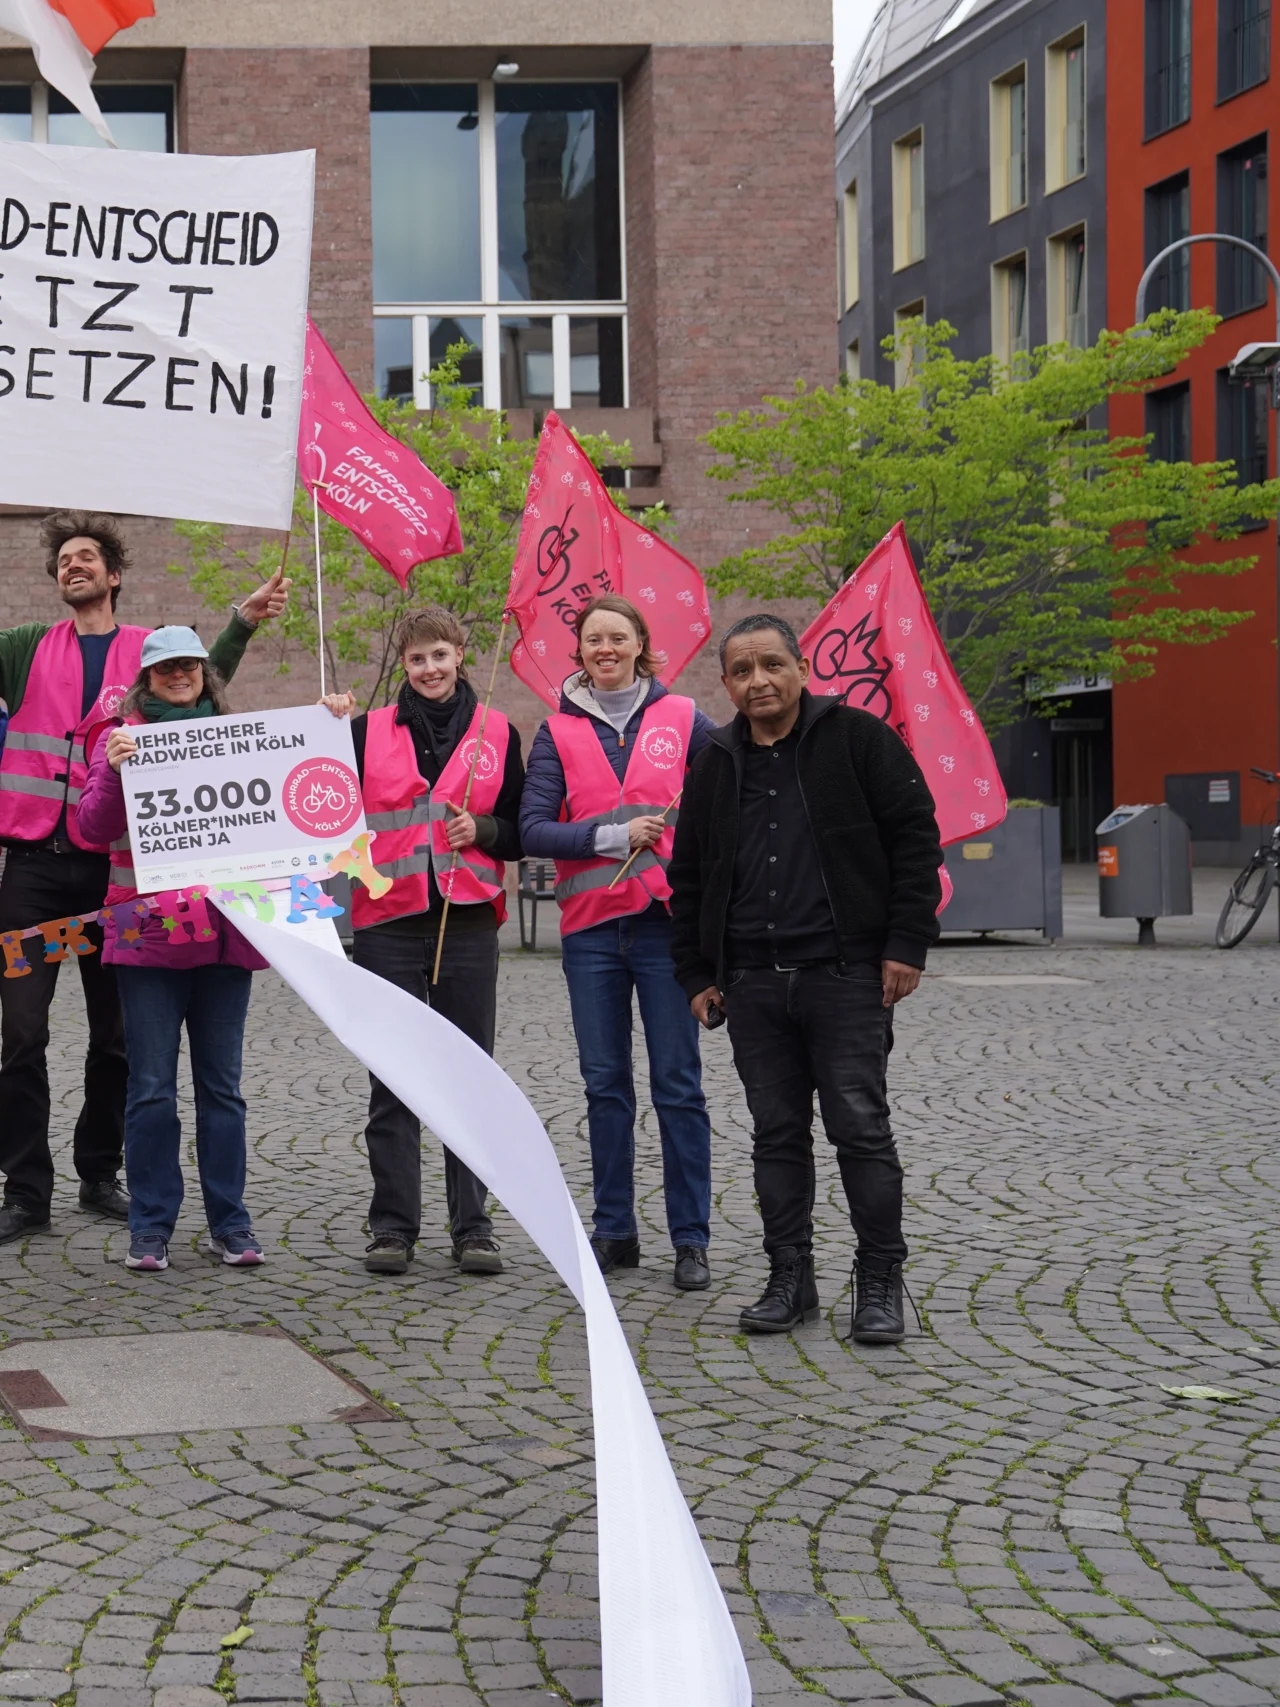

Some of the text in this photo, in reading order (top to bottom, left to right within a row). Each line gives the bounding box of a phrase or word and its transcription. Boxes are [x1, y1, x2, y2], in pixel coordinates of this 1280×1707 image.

[326, 481, 373, 514] KÖLN
[332, 462, 428, 535] ENTSCHEID
[346, 446, 428, 519] FAHRRAD
[185, 722, 266, 743] SICHERE
[127, 743, 226, 767] RADWEGE
[231, 740, 250, 755] IN
[134, 778, 272, 820] 33.000
[288, 764, 357, 811] FAHRRAD ENTSCHEID
[314, 820, 341, 831] KÖLN
[139, 832, 231, 854] SAGEN JA
